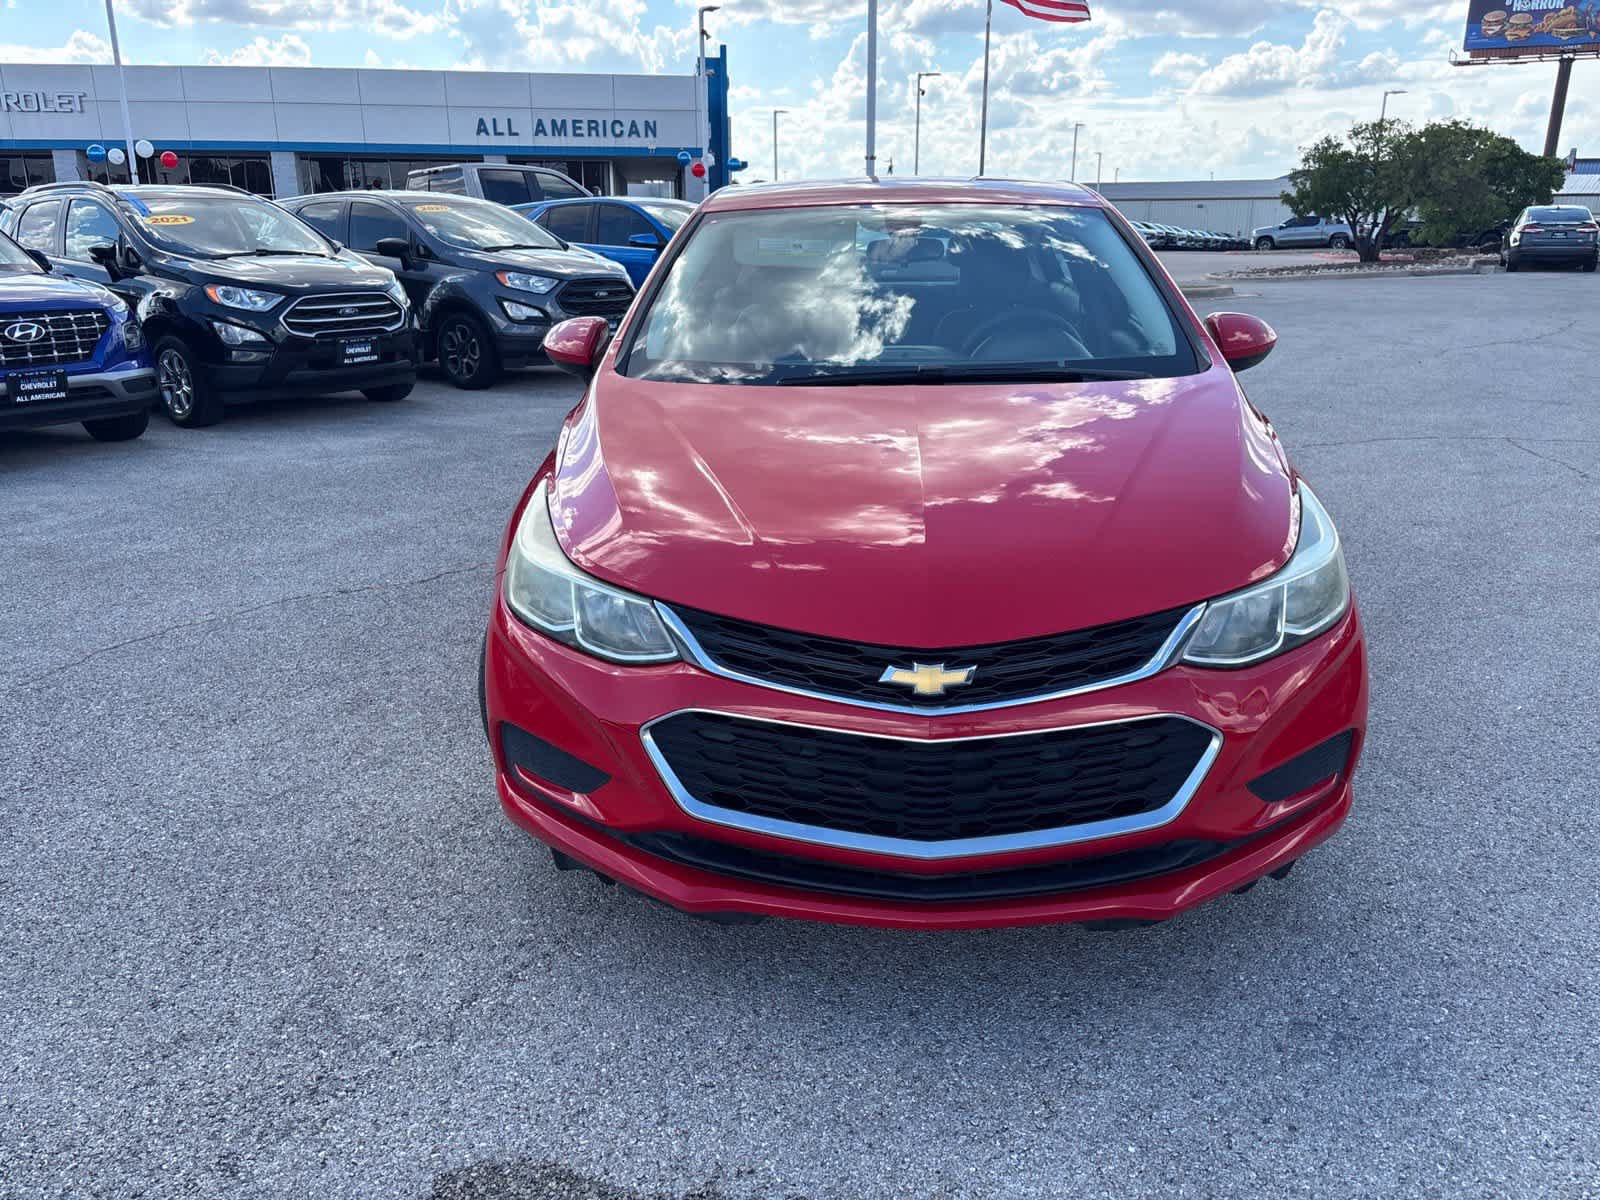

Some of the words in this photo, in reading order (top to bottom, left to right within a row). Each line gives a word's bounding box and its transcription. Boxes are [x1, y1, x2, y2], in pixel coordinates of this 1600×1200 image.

[475, 117, 520, 137] ALL
[534, 118, 657, 138] AMERICAN
[150, 216, 189, 224] 2021
[20, 381, 57, 391] CHEVROLET
[30, 392, 66, 401] AMERICAN
